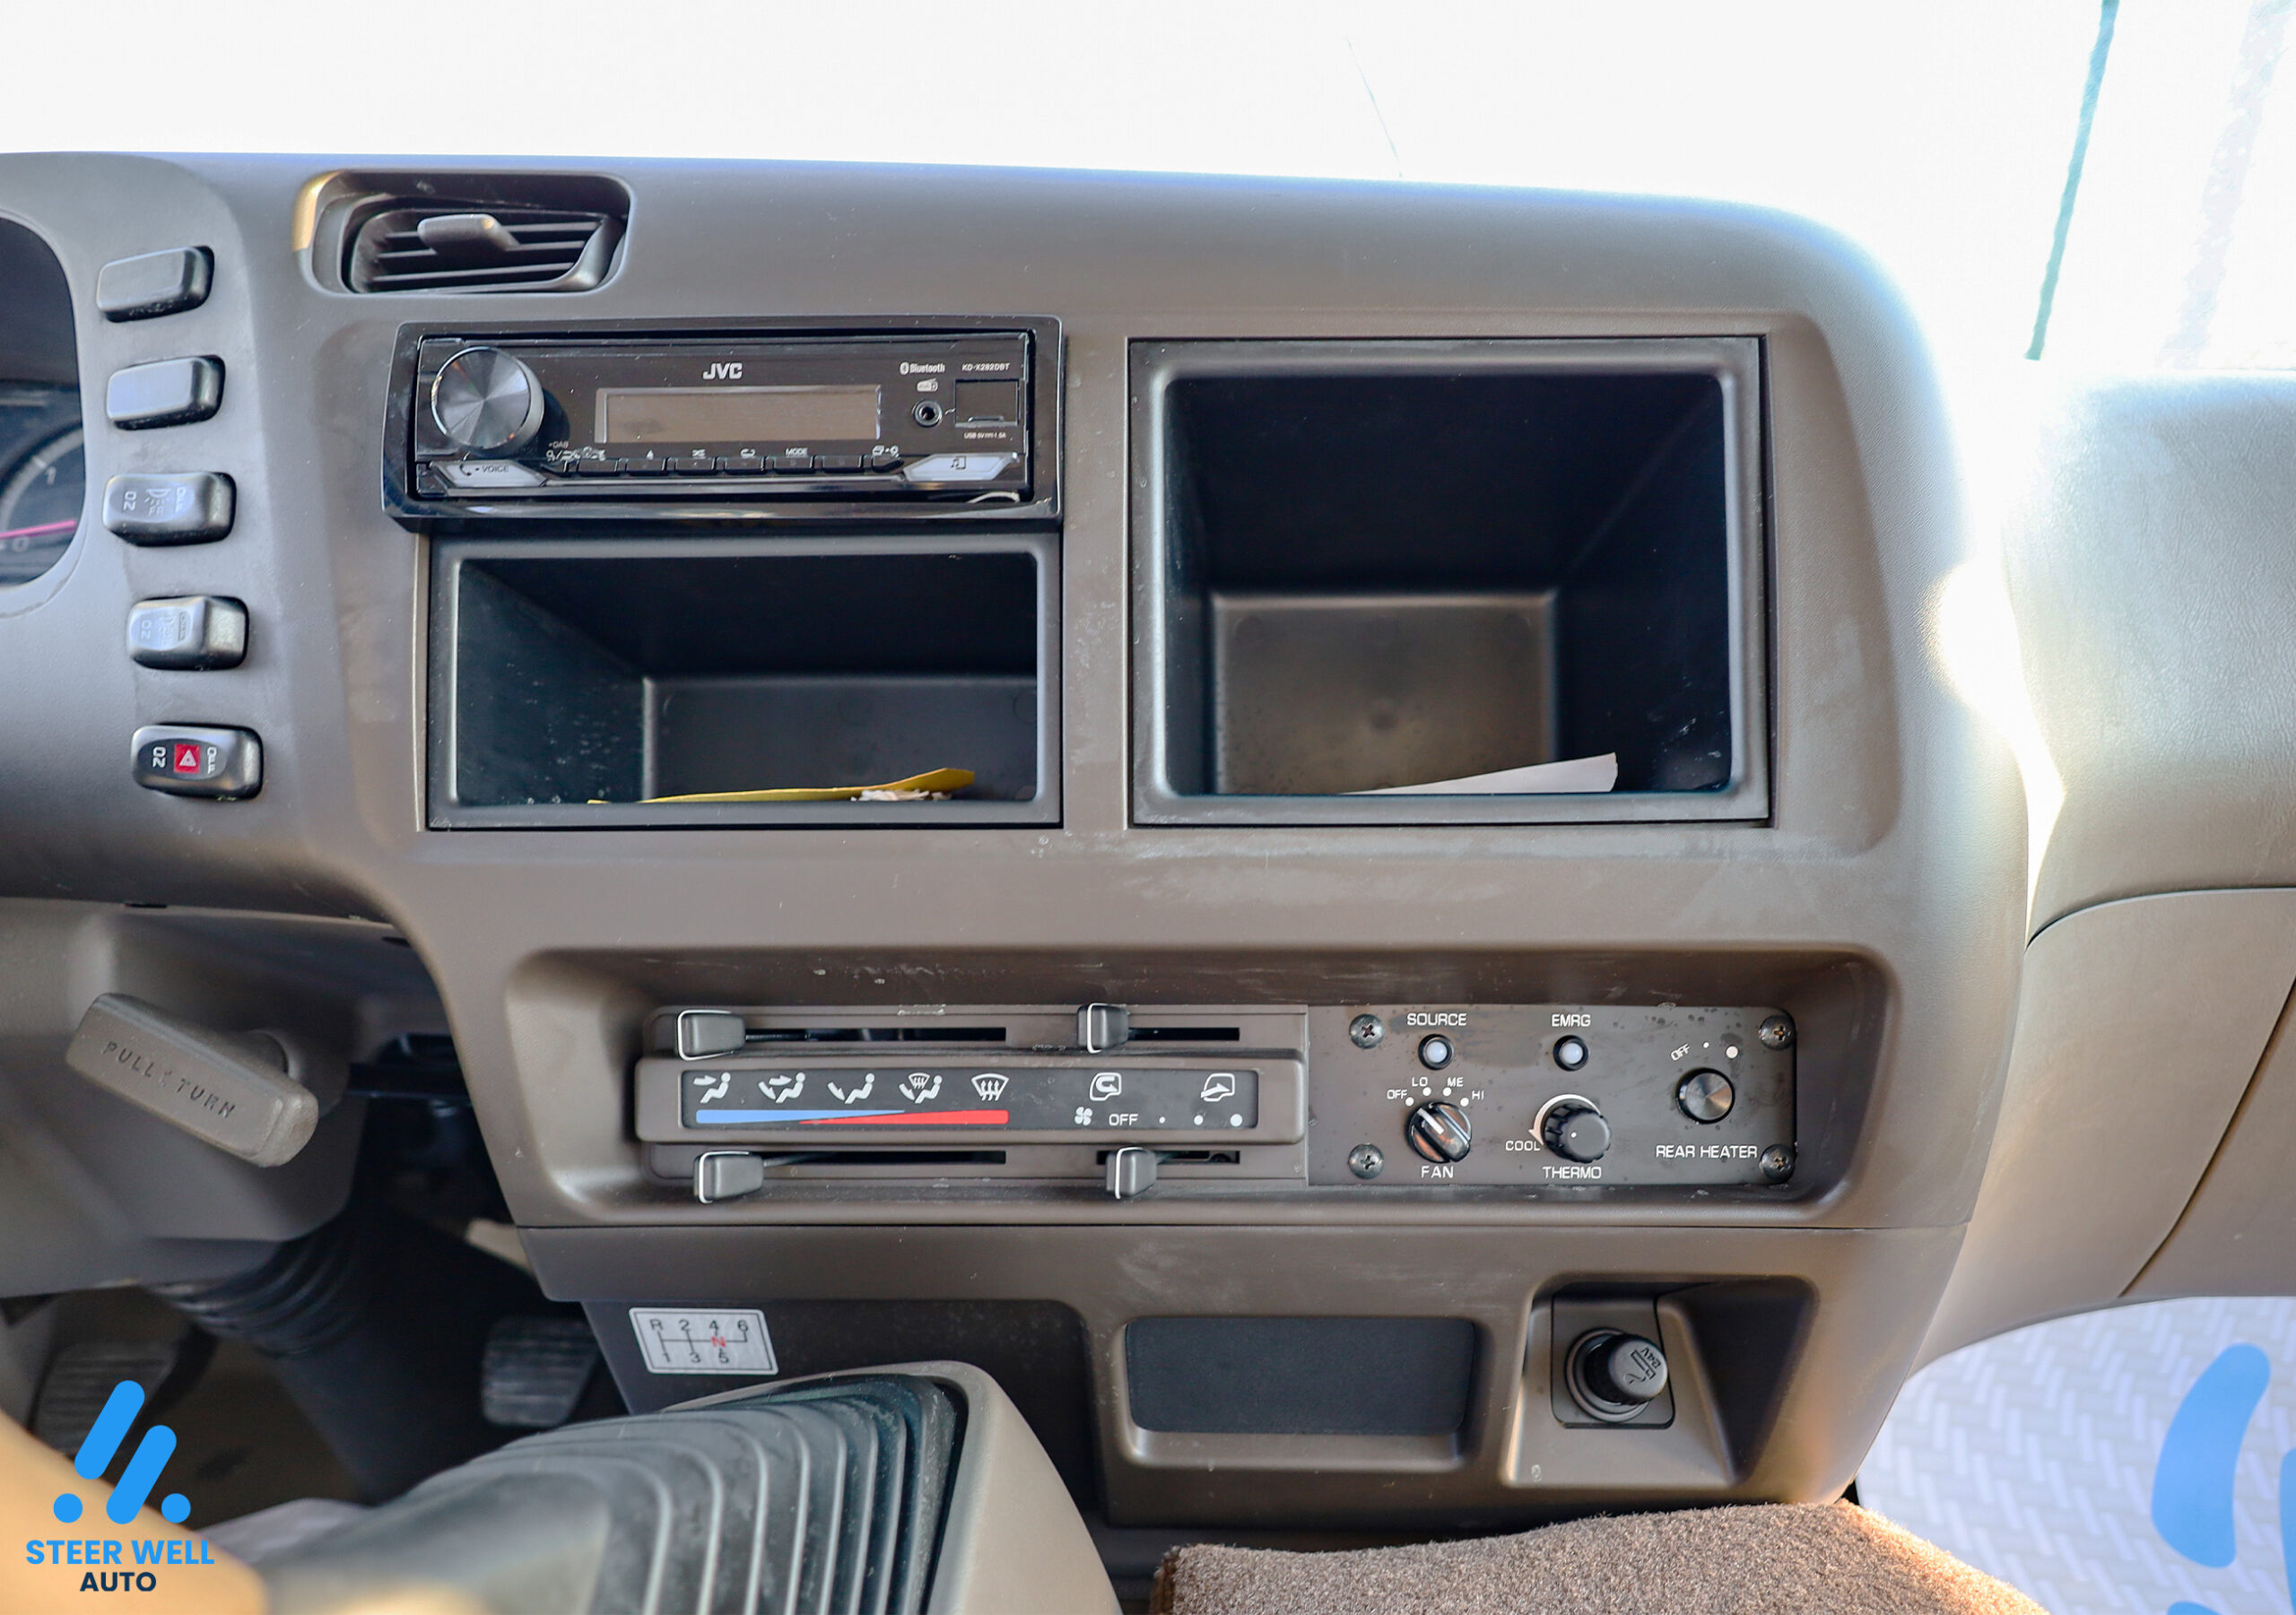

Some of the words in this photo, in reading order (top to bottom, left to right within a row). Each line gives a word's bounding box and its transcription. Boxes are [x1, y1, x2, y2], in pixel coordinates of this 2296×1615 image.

[703, 362, 743, 379] JVC
[909, 362, 945, 373] Bluetooth
[786, 447, 807, 456] MODE
[482, 465, 509, 473] VOICE
[152, 746, 167, 768] ON
[206, 746, 217, 775] OFF
[1406, 1013, 1467, 1026] SOURCE
[1552, 1014, 1591, 1027] EMRG
[1670, 1043, 1691, 1062] OFF
[102, 1040, 153, 1079] PULL
[175, 1078, 236, 1119] TURN
[1412, 1077, 1429, 1087] LO
[1447, 1077, 1464, 1087] ME
[1387, 1090, 1408, 1099] OFF
[1472, 1090, 1484, 1100] HI
[1109, 1113, 1139, 1125] OFF
[1505, 1141, 1541, 1150] COOL
[1656, 1145, 1695, 1158] REAR
[1700, 1145, 1758, 1158] HEATER
[1421, 1166, 1454, 1178] FAN
[1543, 1166, 1602, 1179] THERMO
[649, 1319, 664, 1331] R
[679, 1319, 691, 1331] 2
[709, 1320, 719, 1331] 4
[737, 1319, 749, 1332] 6
[710, 1336, 726, 1347] N
[689, 1352, 701, 1363] 3
[1640, 1347, 1662, 1369] 24V
